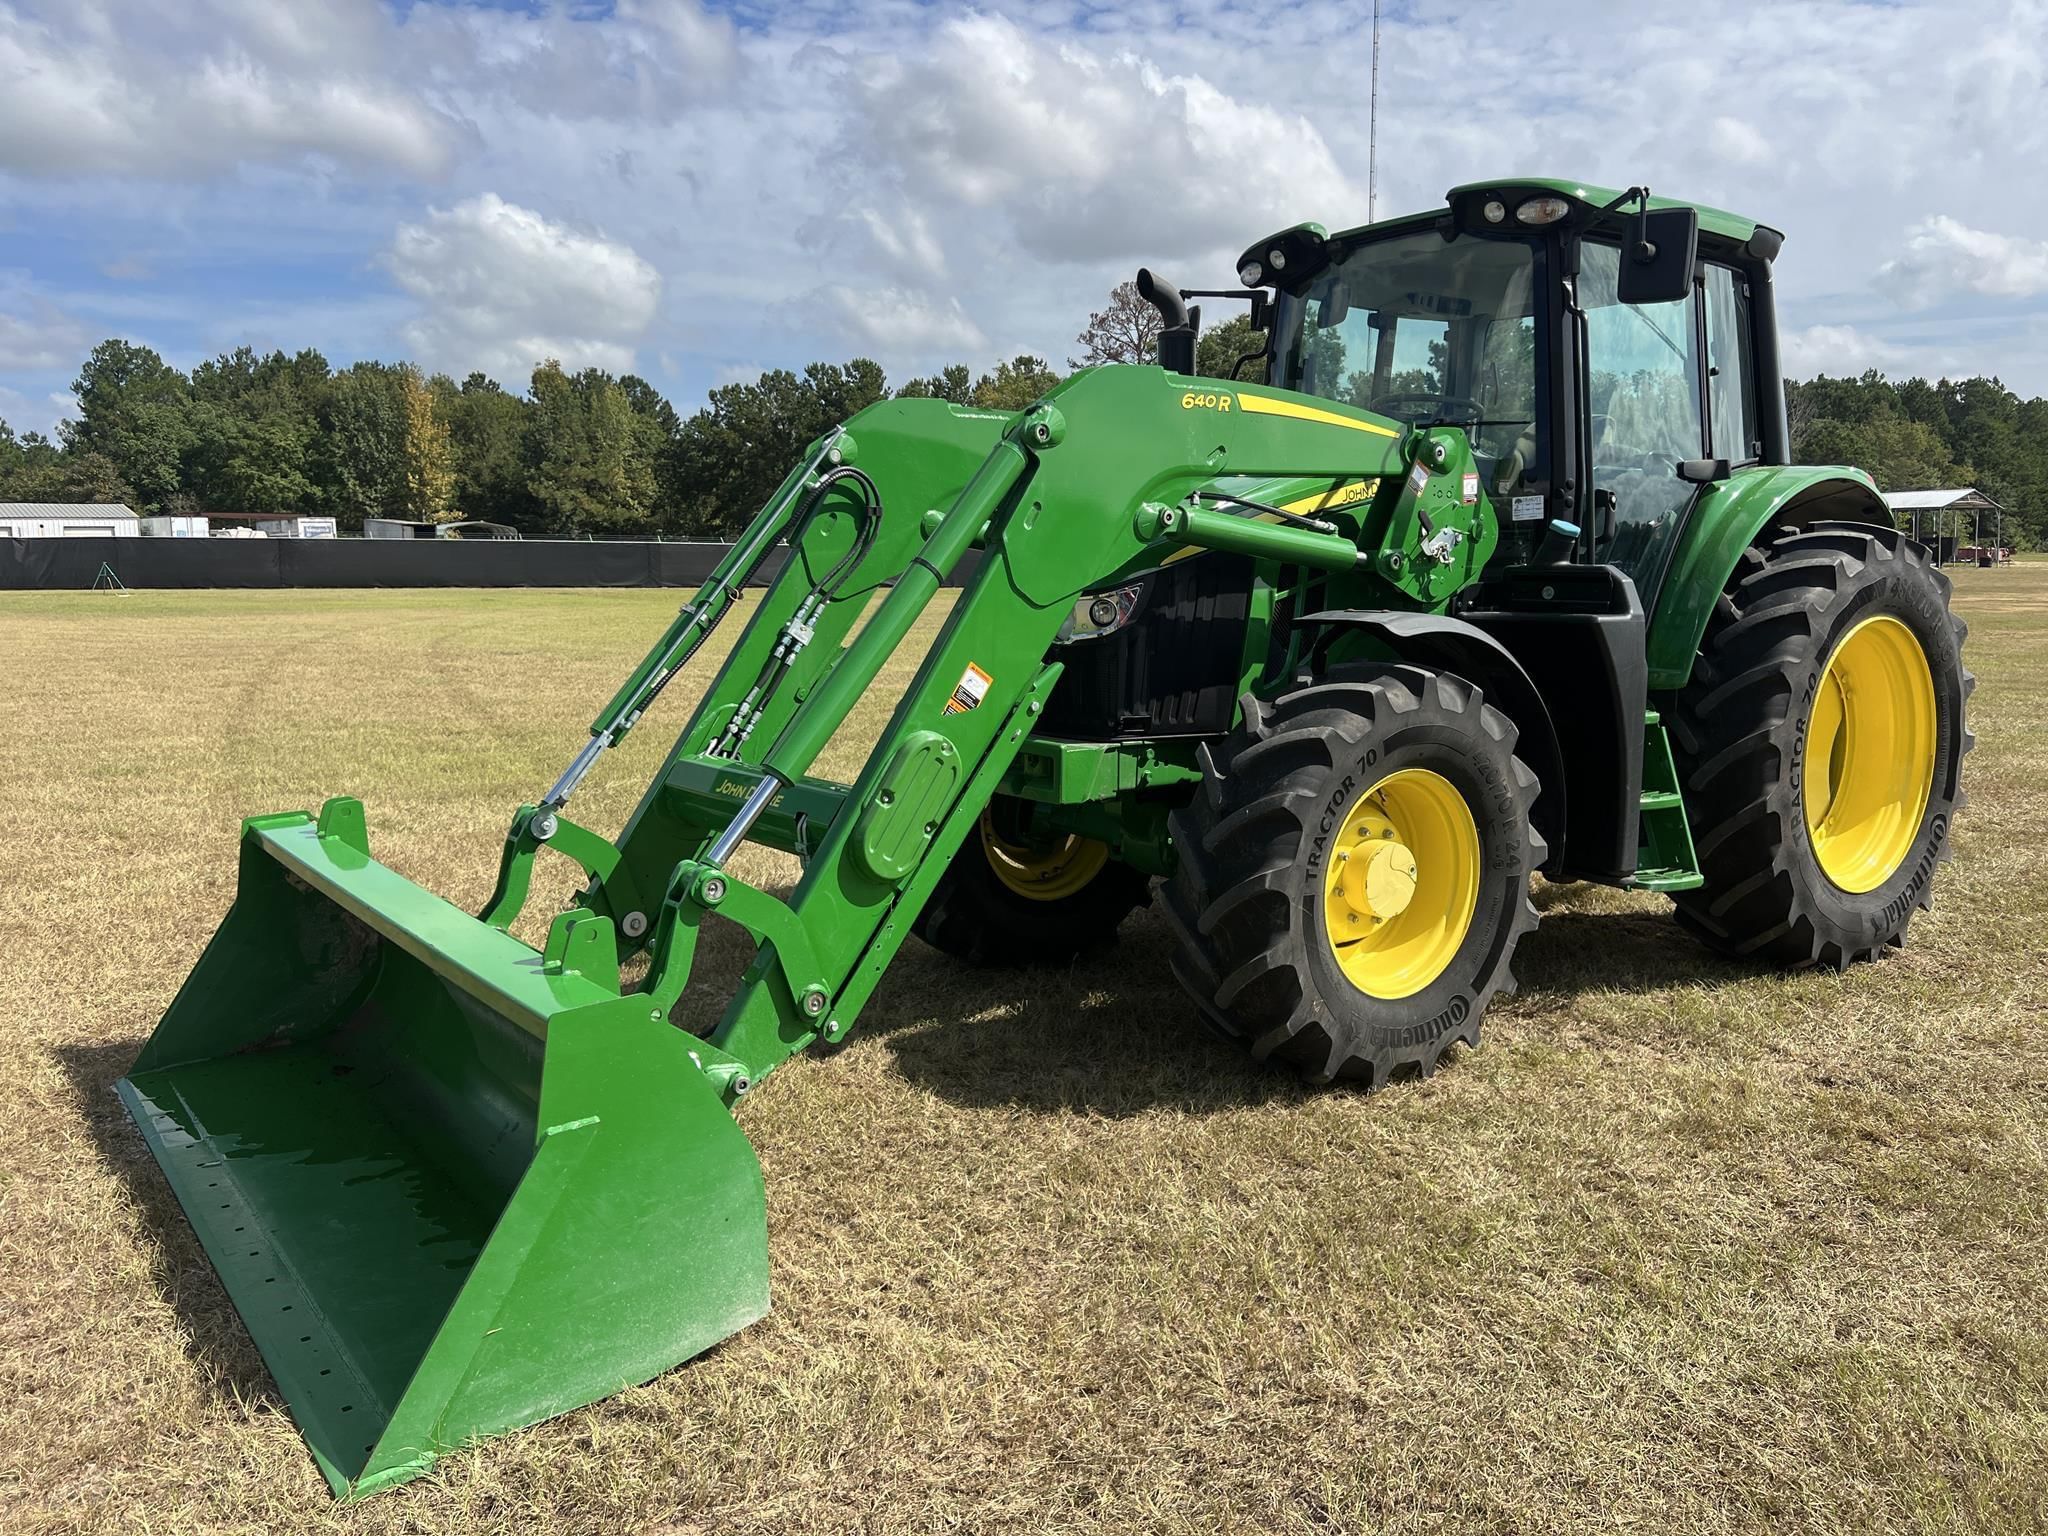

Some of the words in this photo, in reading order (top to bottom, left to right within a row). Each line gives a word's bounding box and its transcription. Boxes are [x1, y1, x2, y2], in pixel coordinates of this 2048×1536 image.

[1342, 487, 1369, 502] JOHN
[1790, 717, 1807, 848] TRACTOR
[1802, 672, 1817, 705] 70
[716, 779, 746, 798] JOHN
[1305, 775, 1356, 883] TRACTOR
[1356, 748, 1378, 776] 70
[1505, 839, 1521, 869] 24
[1881, 813, 1948, 933] Continental
[1361, 994, 1470, 1050] Continental
